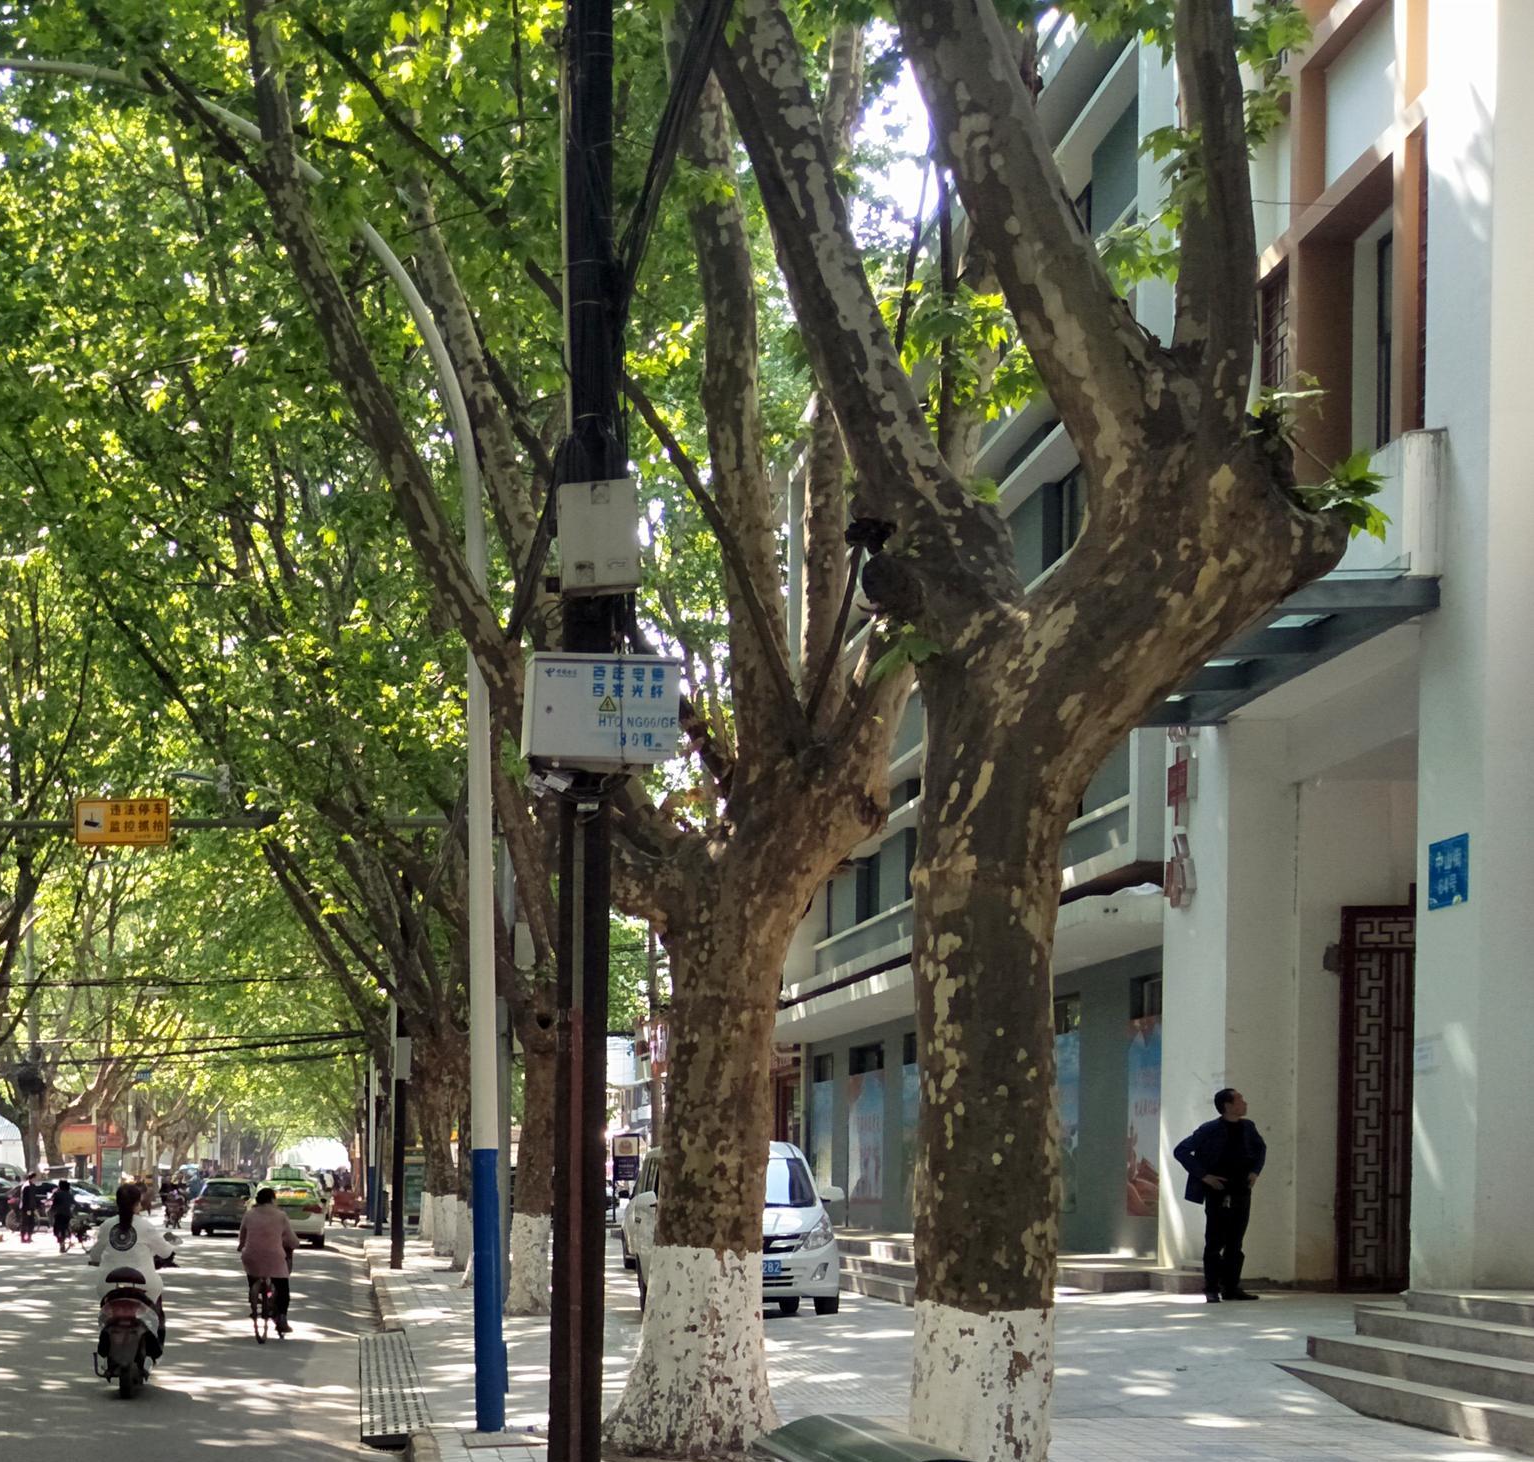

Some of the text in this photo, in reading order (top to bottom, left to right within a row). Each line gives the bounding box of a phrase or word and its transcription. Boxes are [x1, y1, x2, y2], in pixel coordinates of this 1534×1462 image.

[592, 683, 663, 699] 百兆光纤
[110, 803, 164, 816] 违法停车
[109, 820, 164, 833] 监控抓拍
[762, 1261, 780, 1273] 282
